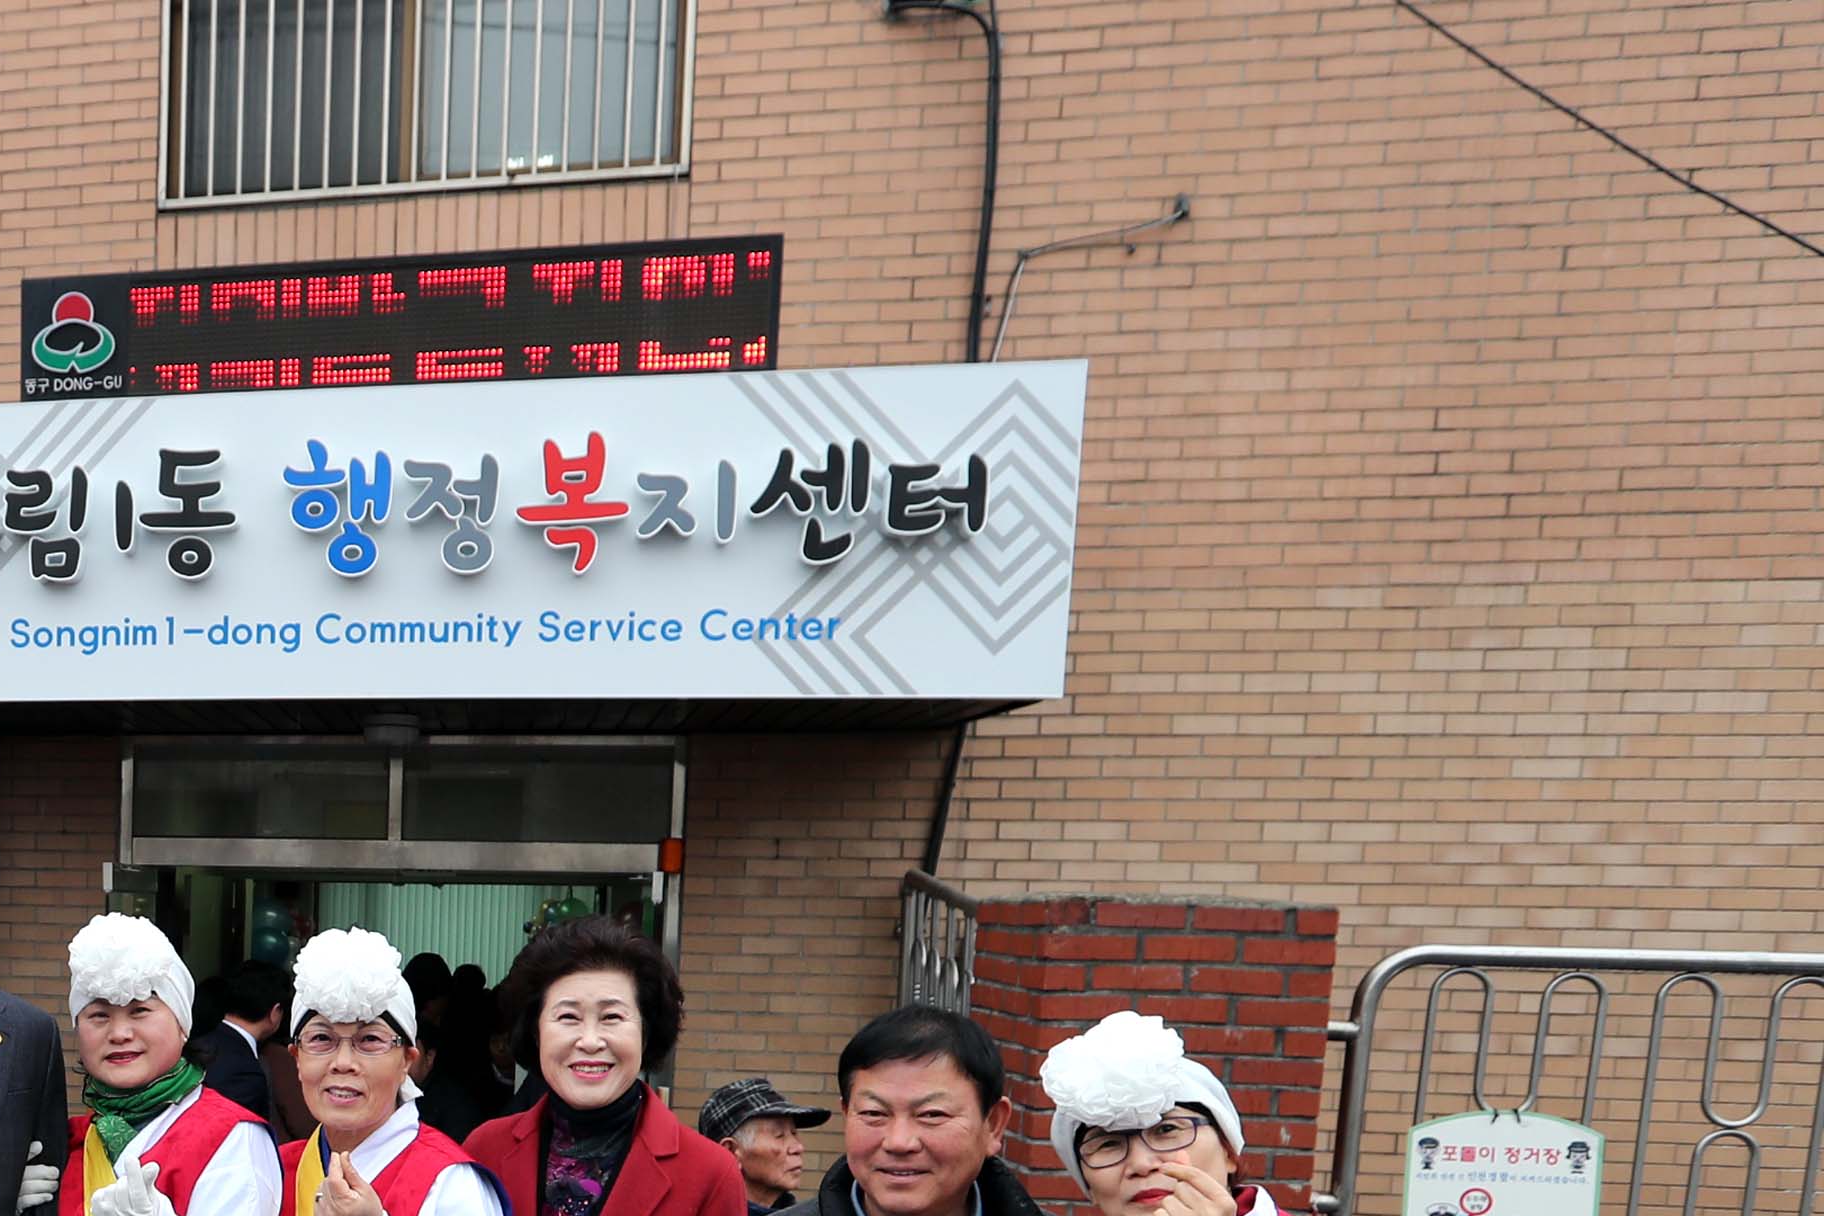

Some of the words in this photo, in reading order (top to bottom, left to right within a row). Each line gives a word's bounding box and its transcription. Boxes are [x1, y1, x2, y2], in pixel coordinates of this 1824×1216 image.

[25, 377, 50, 394] 동구
[53, 375, 123, 392] DONG-GU
[282, 430, 990, 577] 행정복지센터
[315, 611, 522, 647] Community
[538, 609, 683, 643] Service
[700, 608, 842, 642] Center
[1504, 1147, 1562, 1165] 정거장
